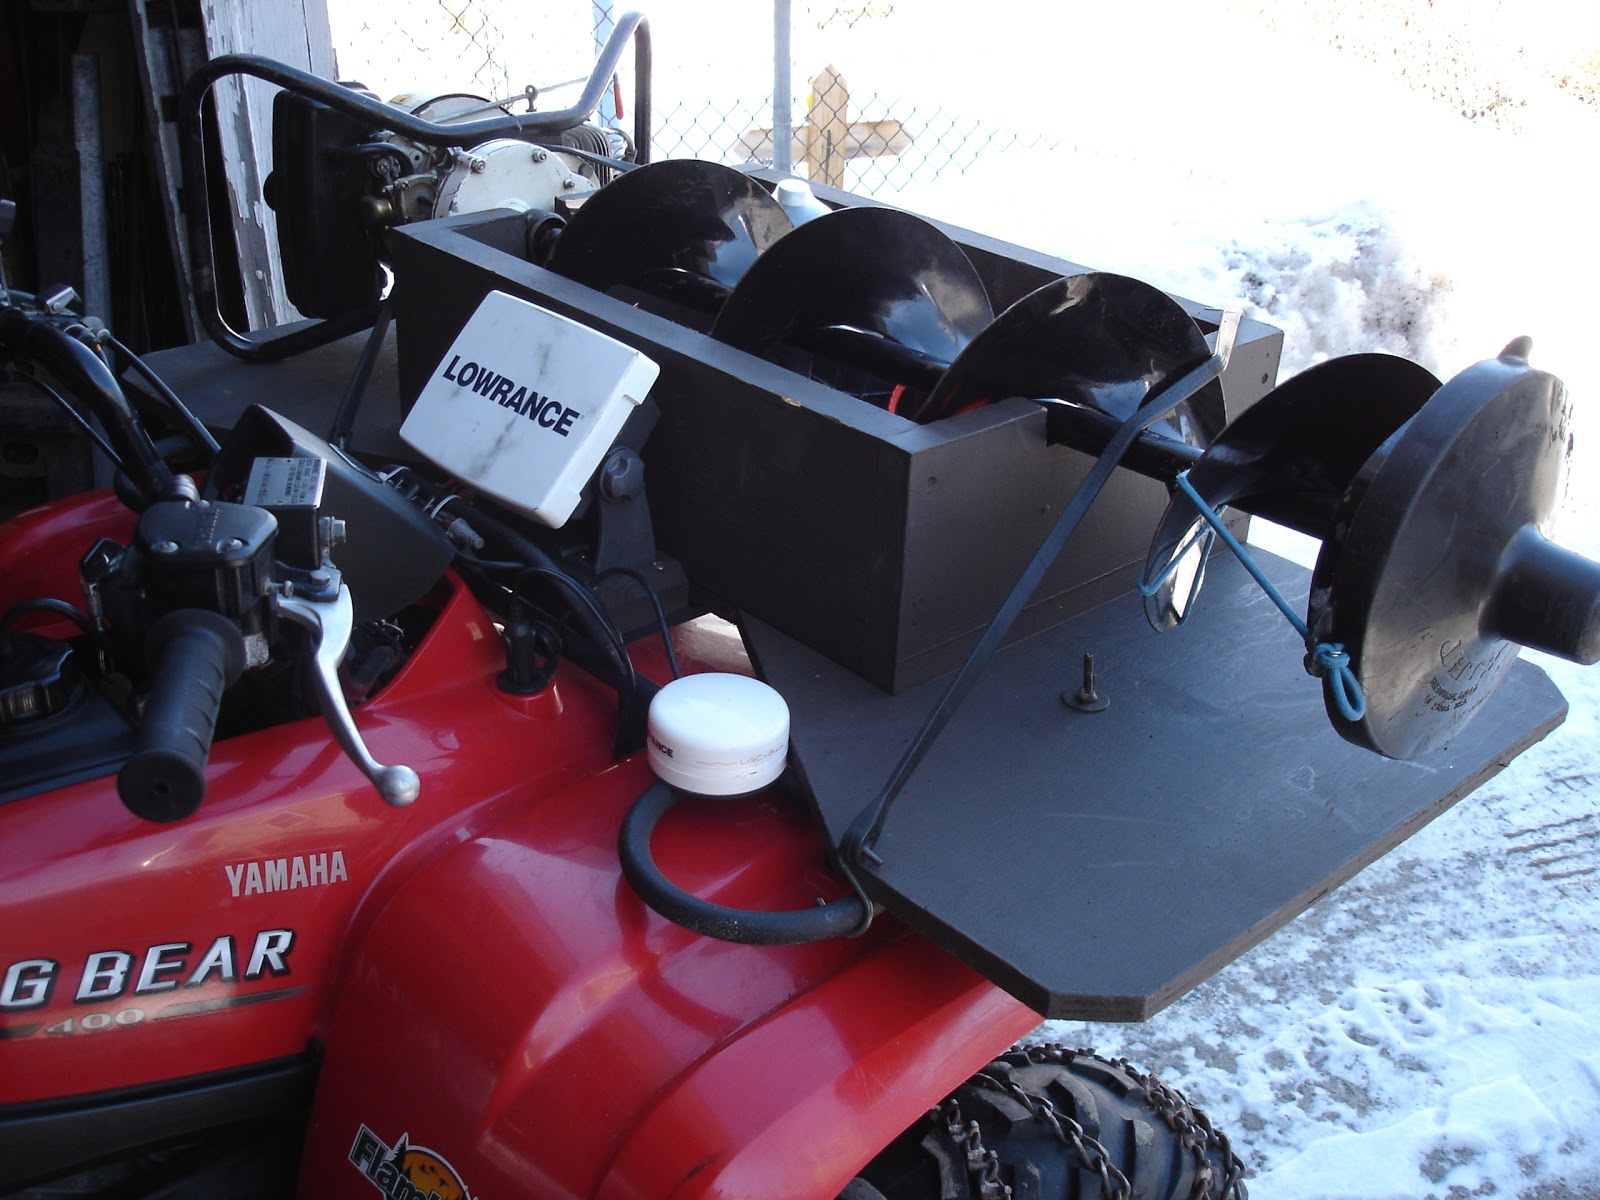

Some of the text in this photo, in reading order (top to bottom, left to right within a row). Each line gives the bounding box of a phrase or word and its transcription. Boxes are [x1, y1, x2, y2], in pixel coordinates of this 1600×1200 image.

[442, 354, 581, 438] LOWRANCE
[650, 735, 674, 758] ANCE
[225, 850, 348, 898] YAMAHA
[0, 928, 294, 1008] G BEAR
[44, 1006, 146, 1035] 400
